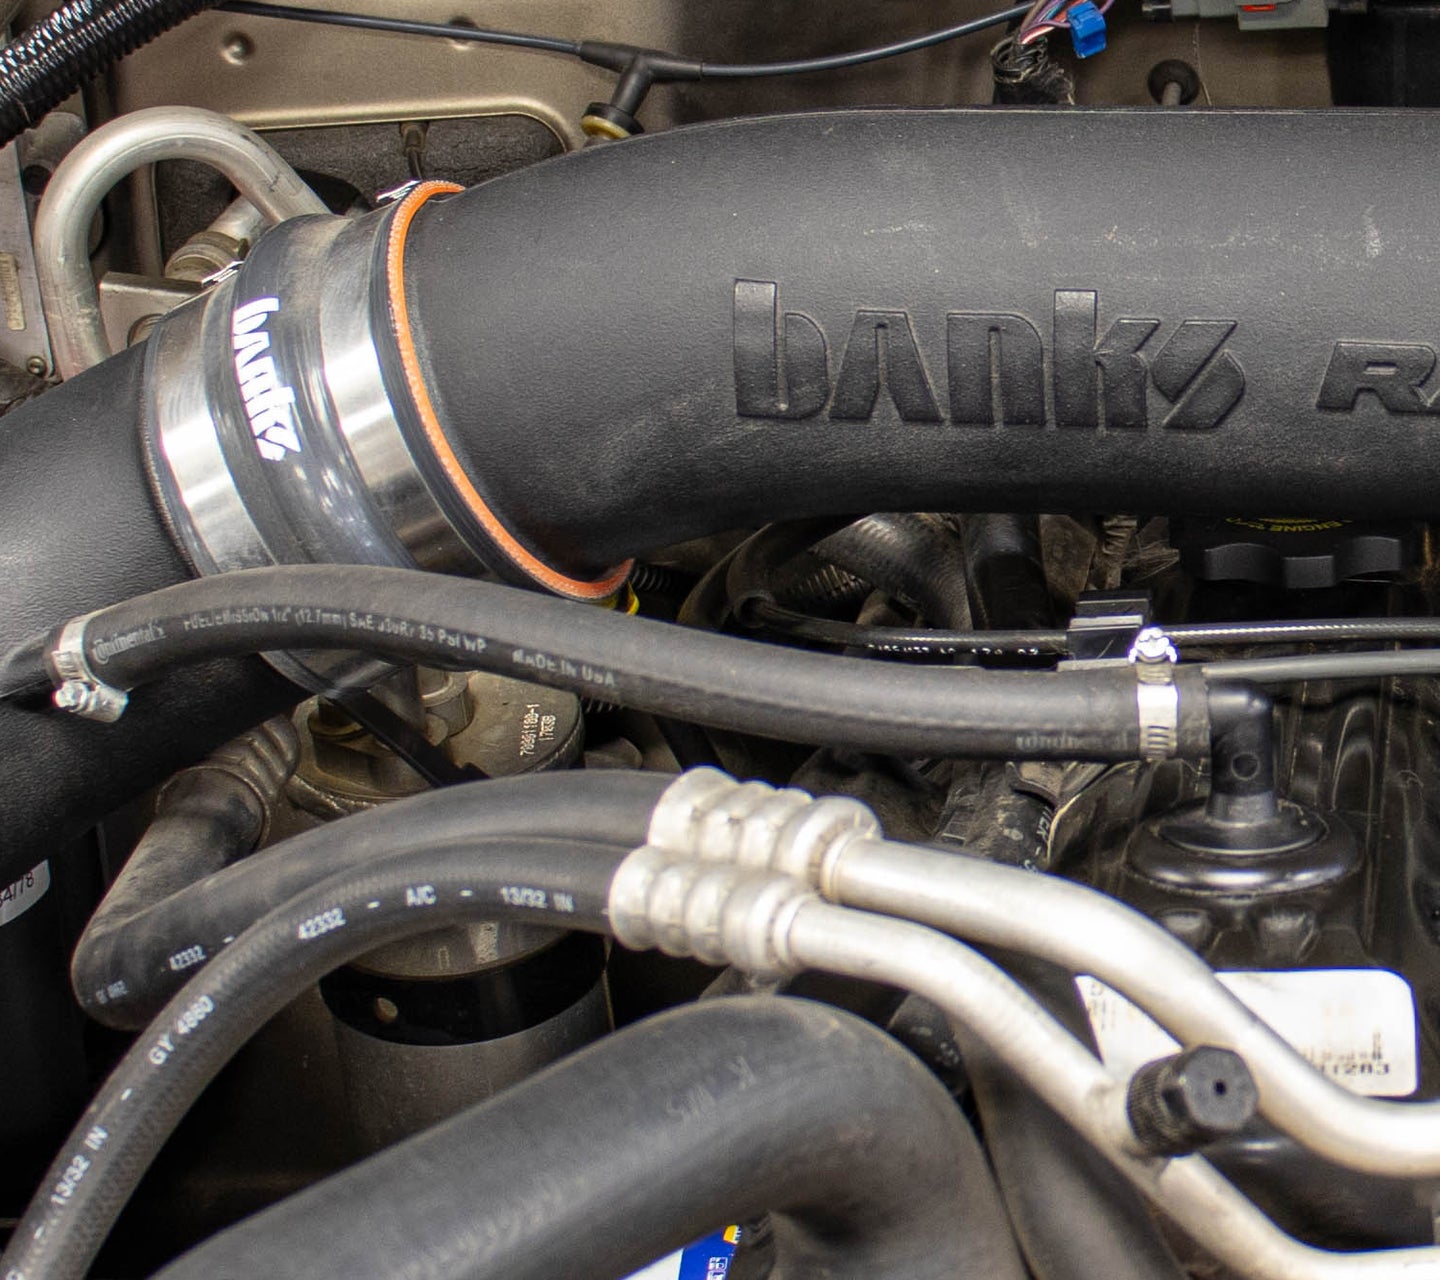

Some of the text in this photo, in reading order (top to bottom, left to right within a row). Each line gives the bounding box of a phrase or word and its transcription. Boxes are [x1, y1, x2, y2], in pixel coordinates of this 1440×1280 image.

[148, 1035, 177, 1066] GY
[298, 908, 347, 941] 42332
[405, 885, 438, 907] A/C
[499, 886, 549, 909] 13/32
[50, 1153, 91, 1206] 13/32
[85, 1125, 109, 1151] IN
